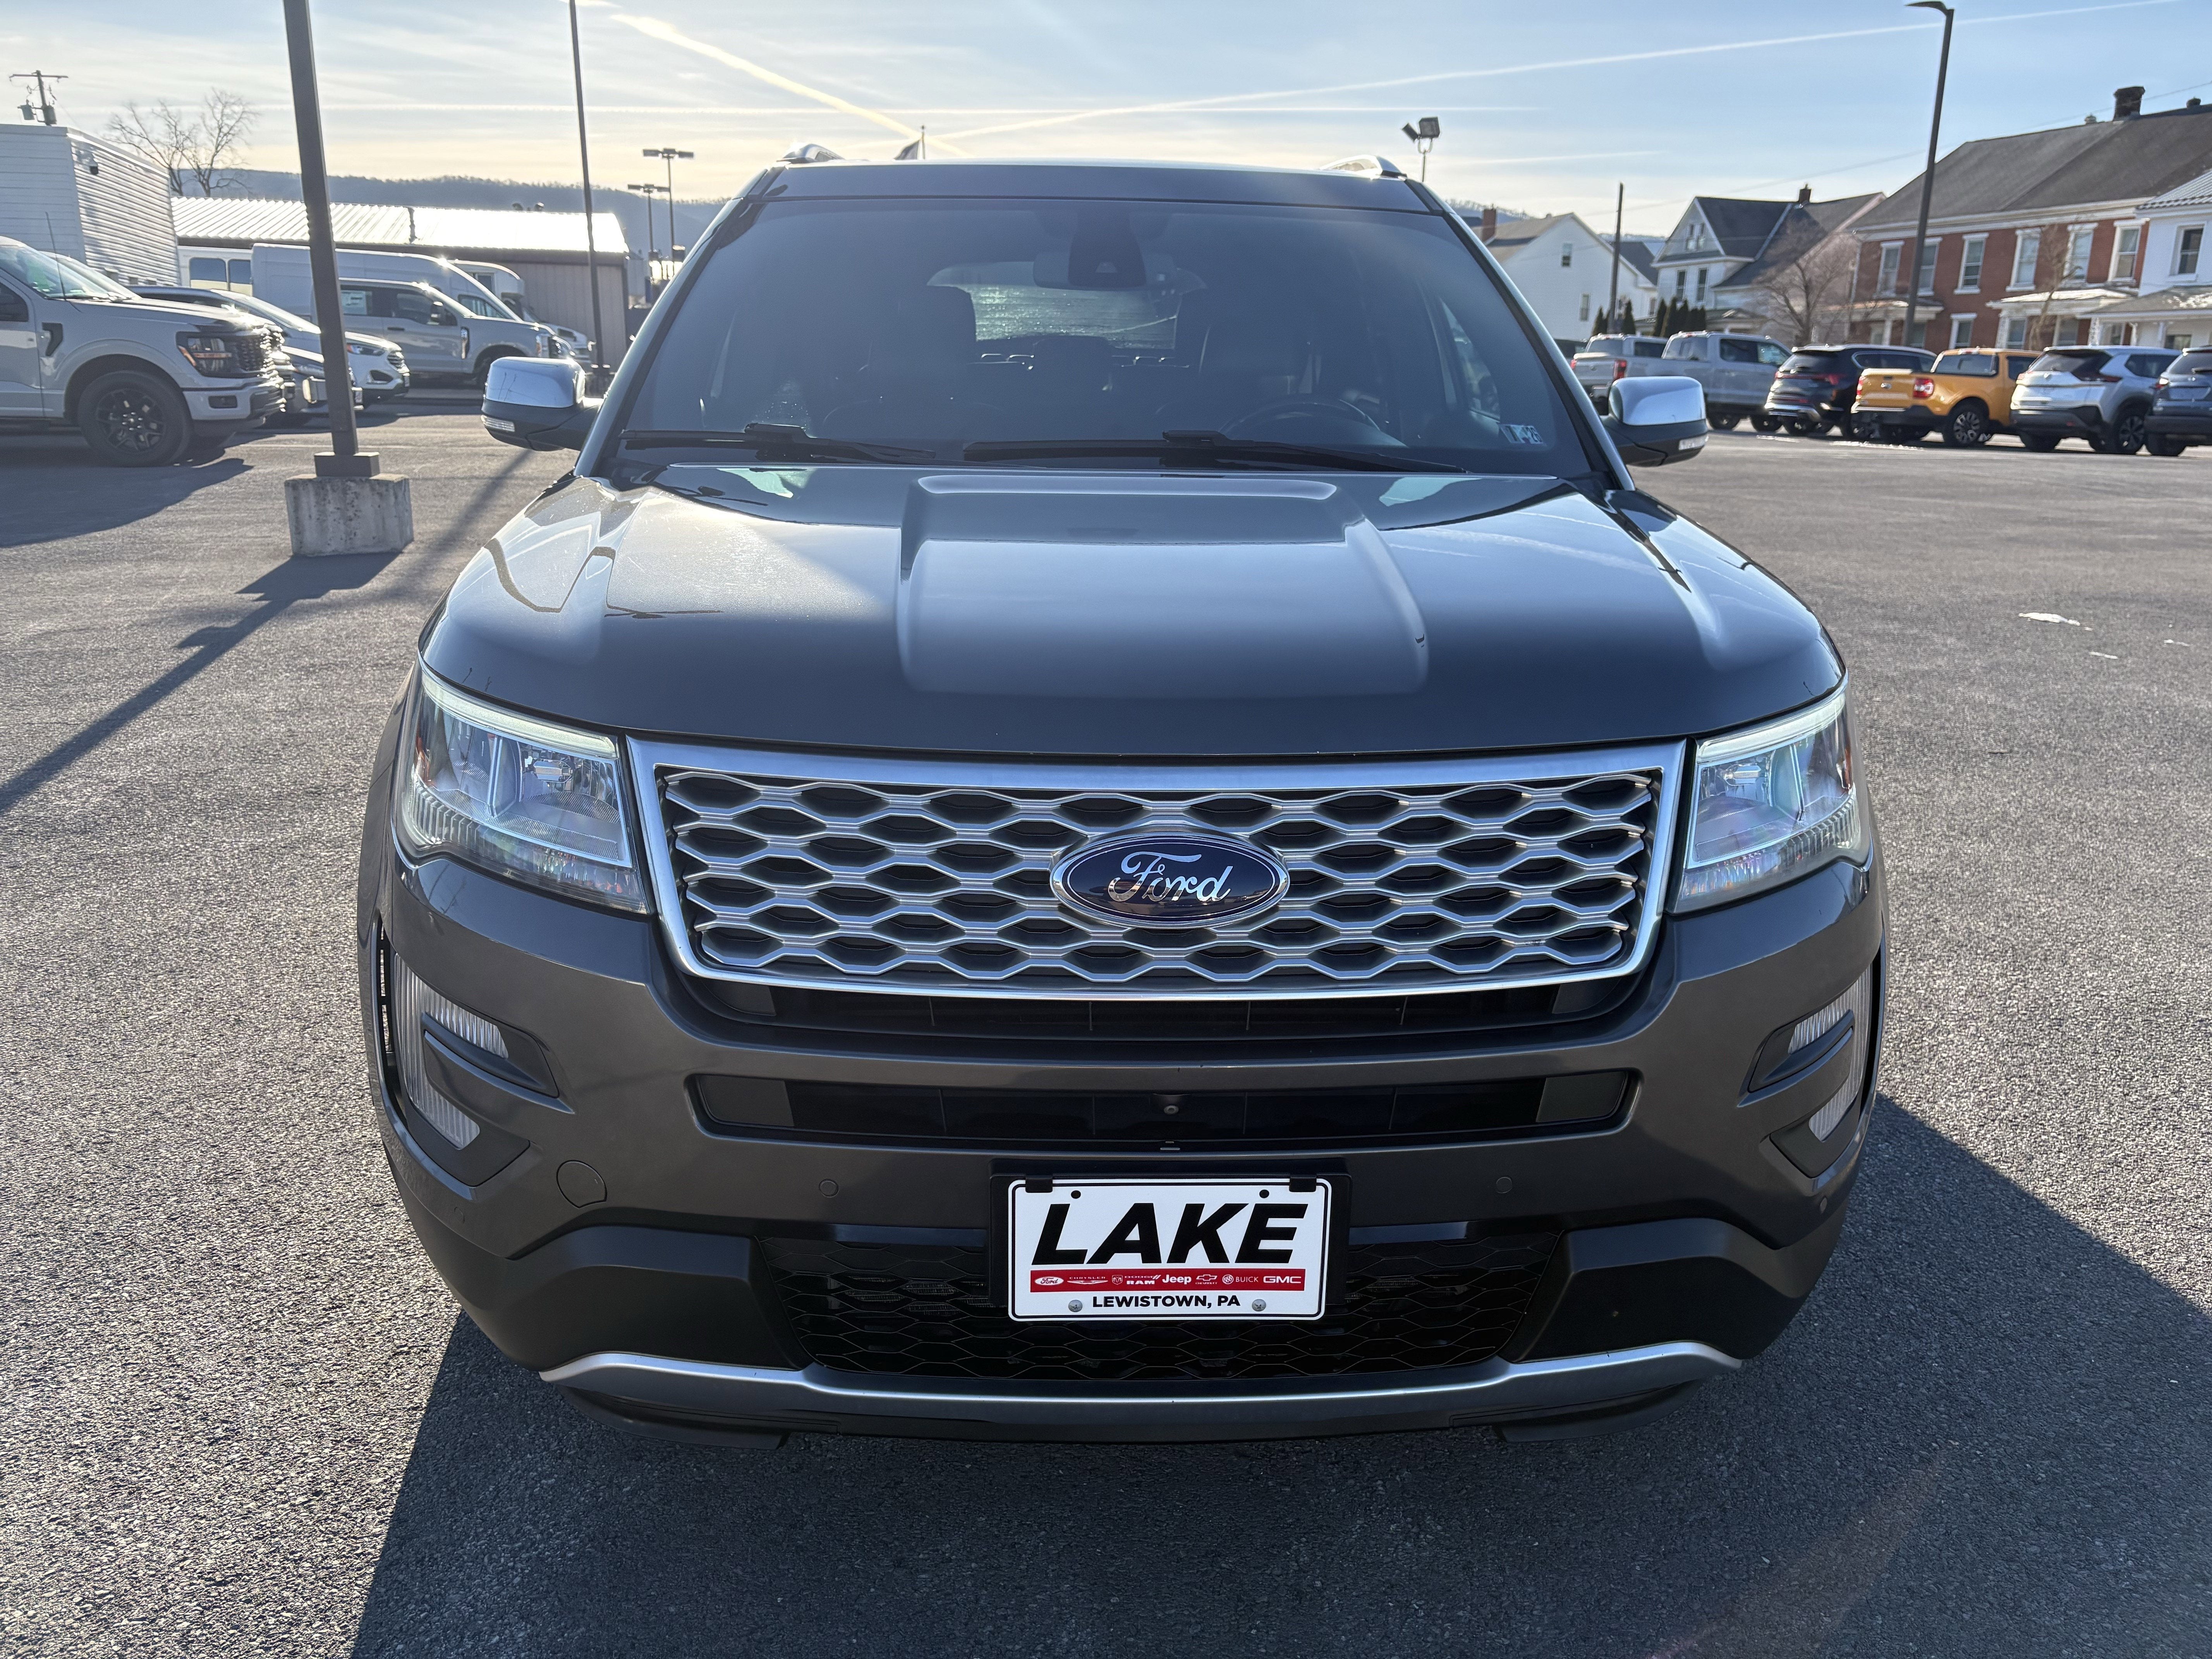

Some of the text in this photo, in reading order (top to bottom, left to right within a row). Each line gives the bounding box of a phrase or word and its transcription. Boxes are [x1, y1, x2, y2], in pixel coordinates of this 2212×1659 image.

[1108, 851, 1234, 902] Ford
[1031, 1203, 1308, 1266] LAKE
[1162, 1274, 1192, 1285] Jeep
[1092, 1295, 1241, 1309] LEWISTOWN, PA
